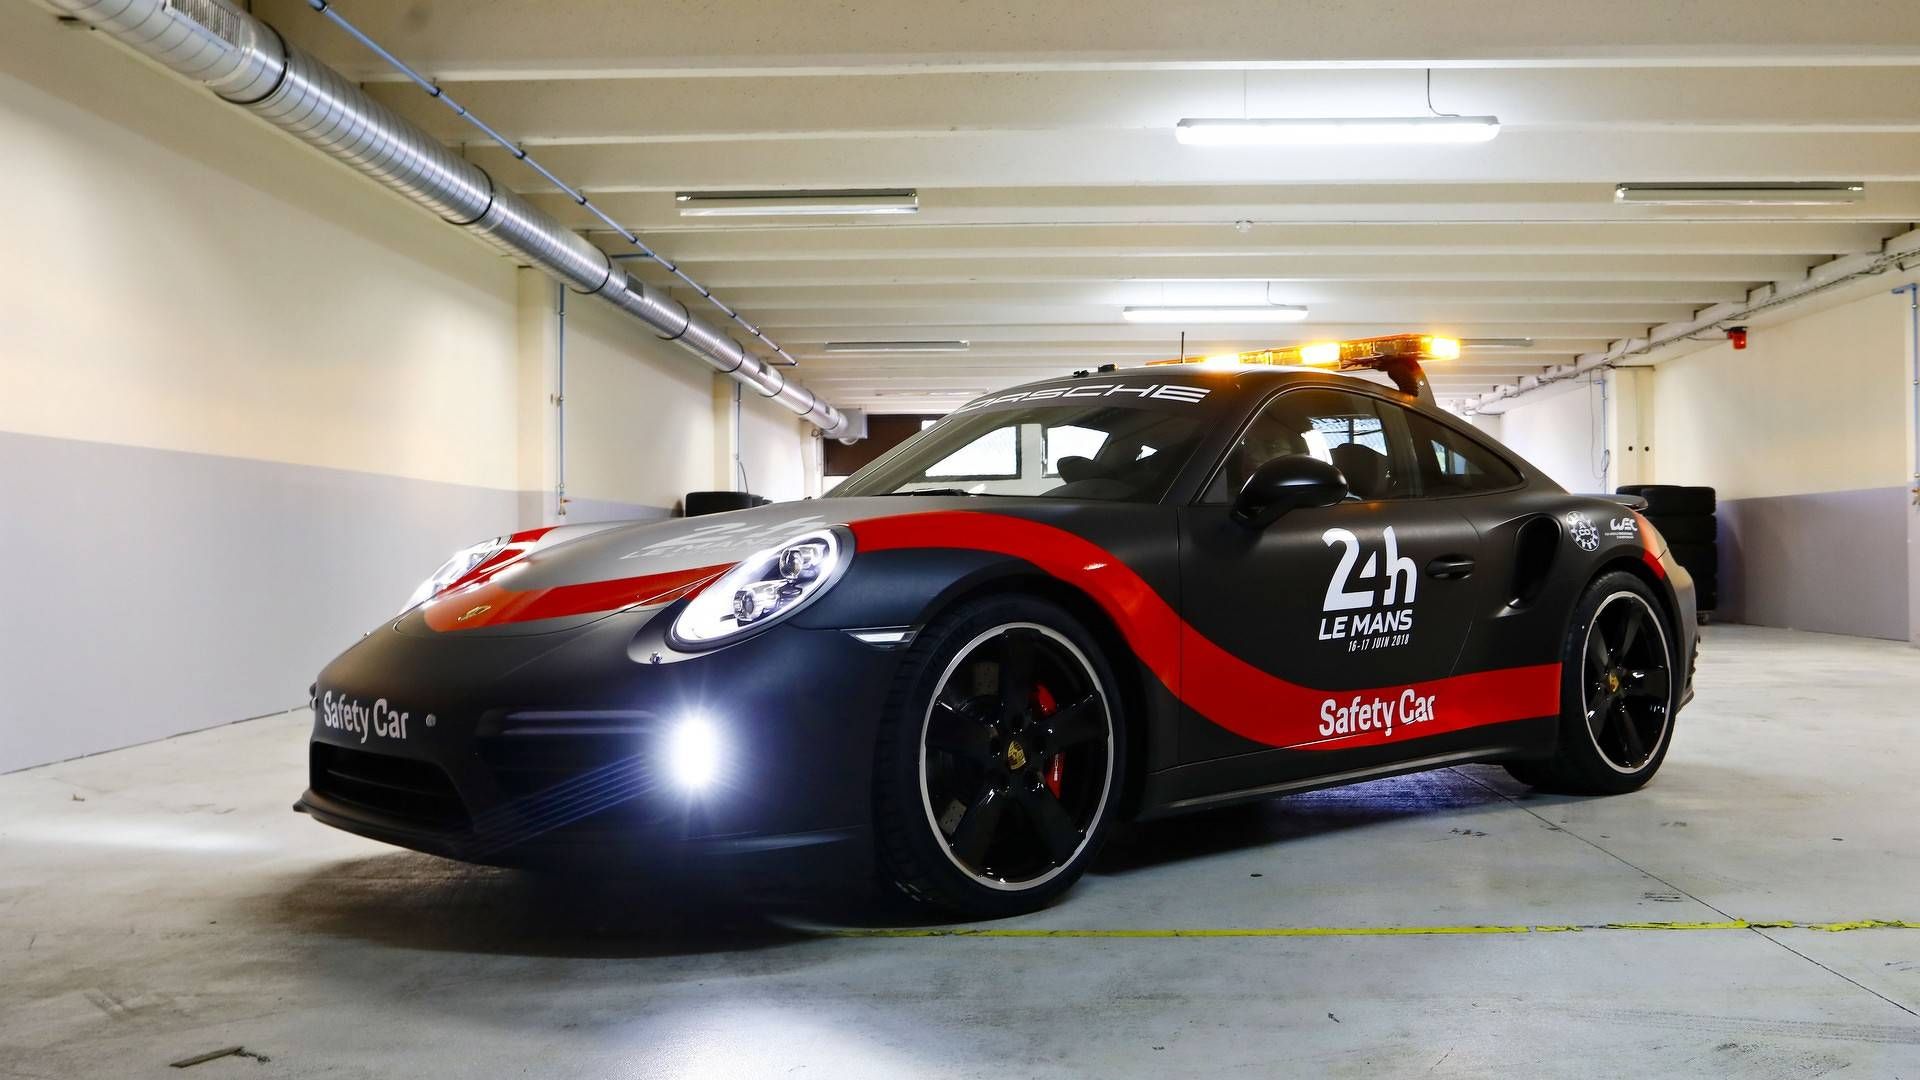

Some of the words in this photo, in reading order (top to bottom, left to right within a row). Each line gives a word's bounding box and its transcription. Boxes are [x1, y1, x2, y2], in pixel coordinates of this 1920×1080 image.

[955, 384, 1211, 414] ORSCHE
[1321, 526, 1417, 611] 24h
[1319, 616, 1348, 640] LE
[1351, 609, 1413, 636] MANS
[1348, 640, 1370, 652] 16-17
[1371, 636, 1389, 649] JUIN
[1391, 633, 1410, 647] 2018
[323, 690, 369, 744] Safety
[373, 698, 409, 739] Car
[1318, 696, 1395, 736] Safety
[1399, 688, 1436, 725] Car
